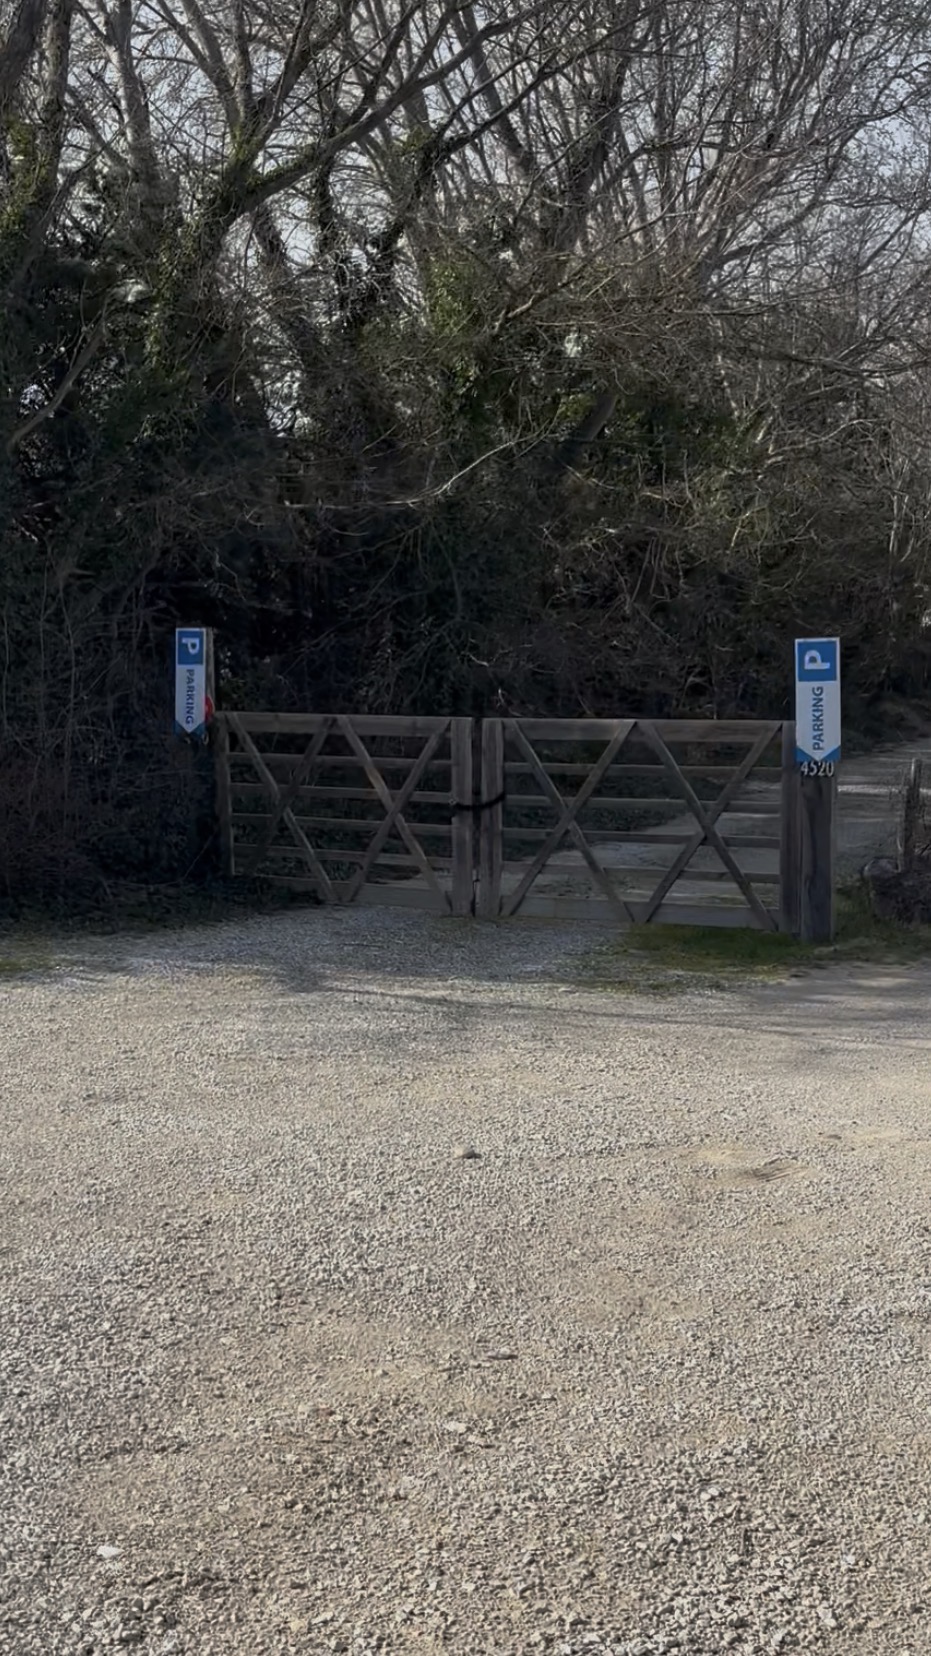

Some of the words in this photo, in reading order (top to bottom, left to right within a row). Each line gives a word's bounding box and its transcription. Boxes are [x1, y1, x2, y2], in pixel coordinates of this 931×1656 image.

[182, 637, 200, 655] P
[804, 650, 830, 670] P
[185, 668, 195, 725] PARKING
[812, 686, 824, 751] PARKING
[800, 760, 834, 776] 4520
